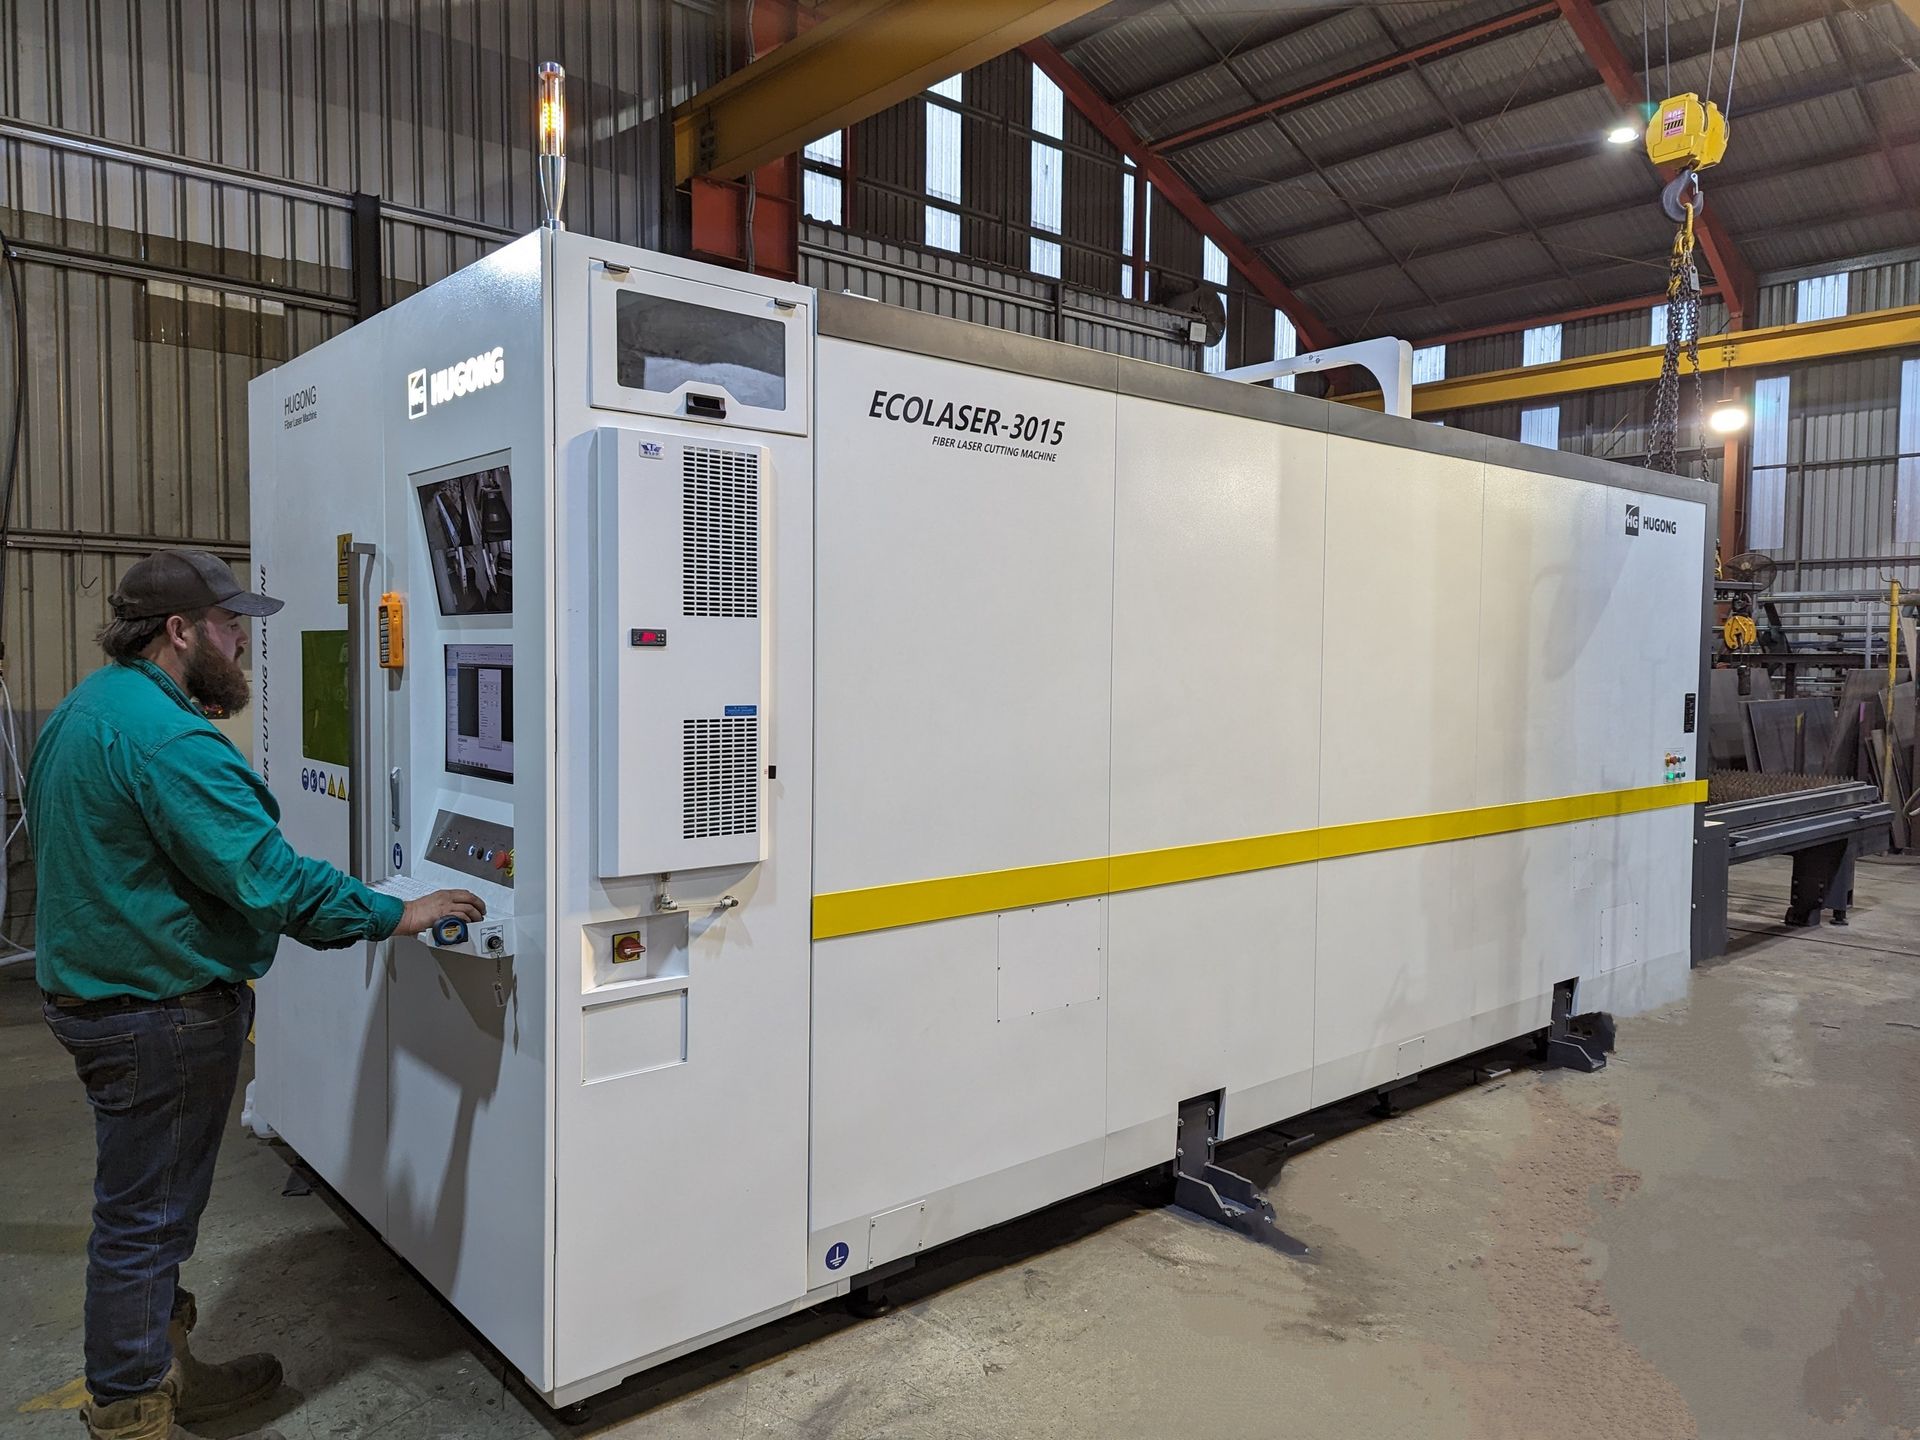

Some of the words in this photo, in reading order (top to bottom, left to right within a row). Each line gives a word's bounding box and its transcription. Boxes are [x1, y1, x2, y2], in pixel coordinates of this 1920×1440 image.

[431, 346, 504, 406] HUGONG
[284, 386, 317, 416] HUGONG
[284, 419, 293, 430] Fiber
[293, 417, 303, 427] Laser
[303, 411, 318, 423] Machine
[869, 390, 1066, 445] ECOLASER-3015
[932, 436, 956, 448] FIBER
[957, 440, 983, 452] LASER
[984, 443, 1020, 457] CUTTING
[1020, 449, 1057, 462] MACHINE
[1643, 516, 1677, 535] HUGONG
